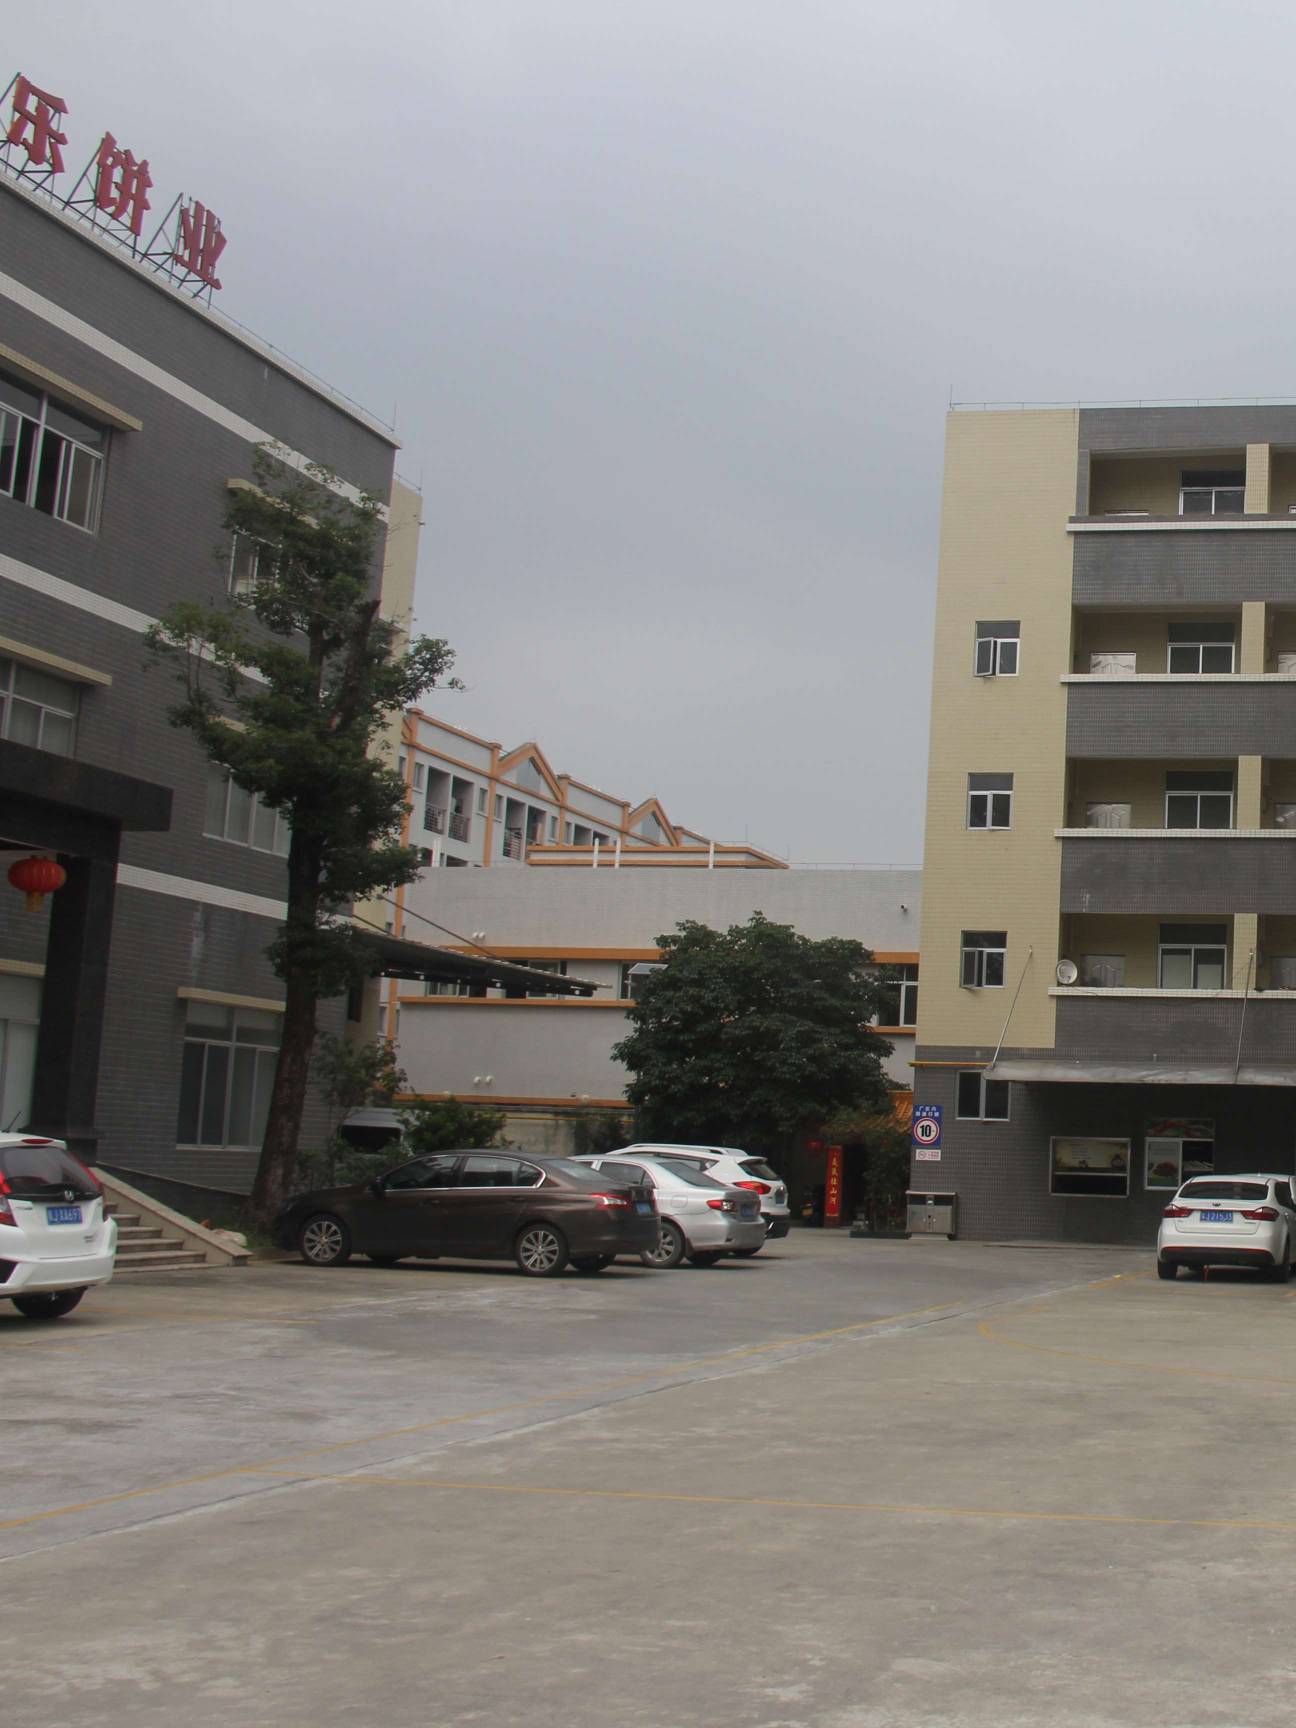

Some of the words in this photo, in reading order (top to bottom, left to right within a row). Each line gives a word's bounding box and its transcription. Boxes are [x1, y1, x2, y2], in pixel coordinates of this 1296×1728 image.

[8, 76, 228, 290] 乐饼业
[920, 1124, 932, 1138] 10
